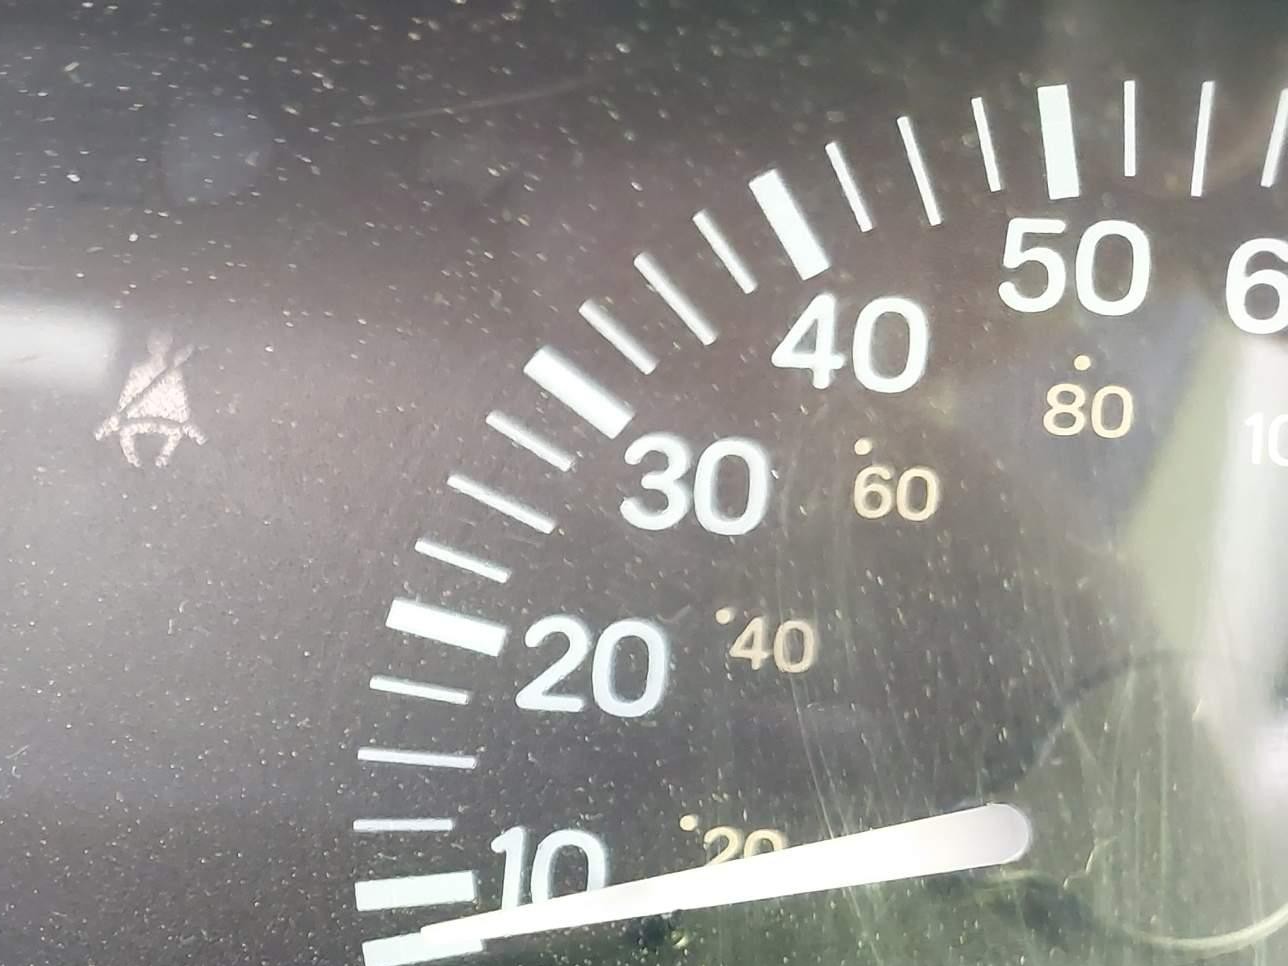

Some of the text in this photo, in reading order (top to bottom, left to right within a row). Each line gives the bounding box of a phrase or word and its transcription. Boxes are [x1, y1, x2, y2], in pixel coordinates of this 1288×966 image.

[998, 217, 1151, 316] 50
[1226, 238, 1288, 335] 6
[772, 293, 930, 393] 40
[1043, 383, 1134, 439] 80
[1245, 412, 1288, 467] 10
[620, 432, 772, 536] 30
[854, 466, 940, 522] 60
[516, 615, 670, 718] 20
[728, 619, 818, 673] 40
[491, 825, 609, 910] 10
